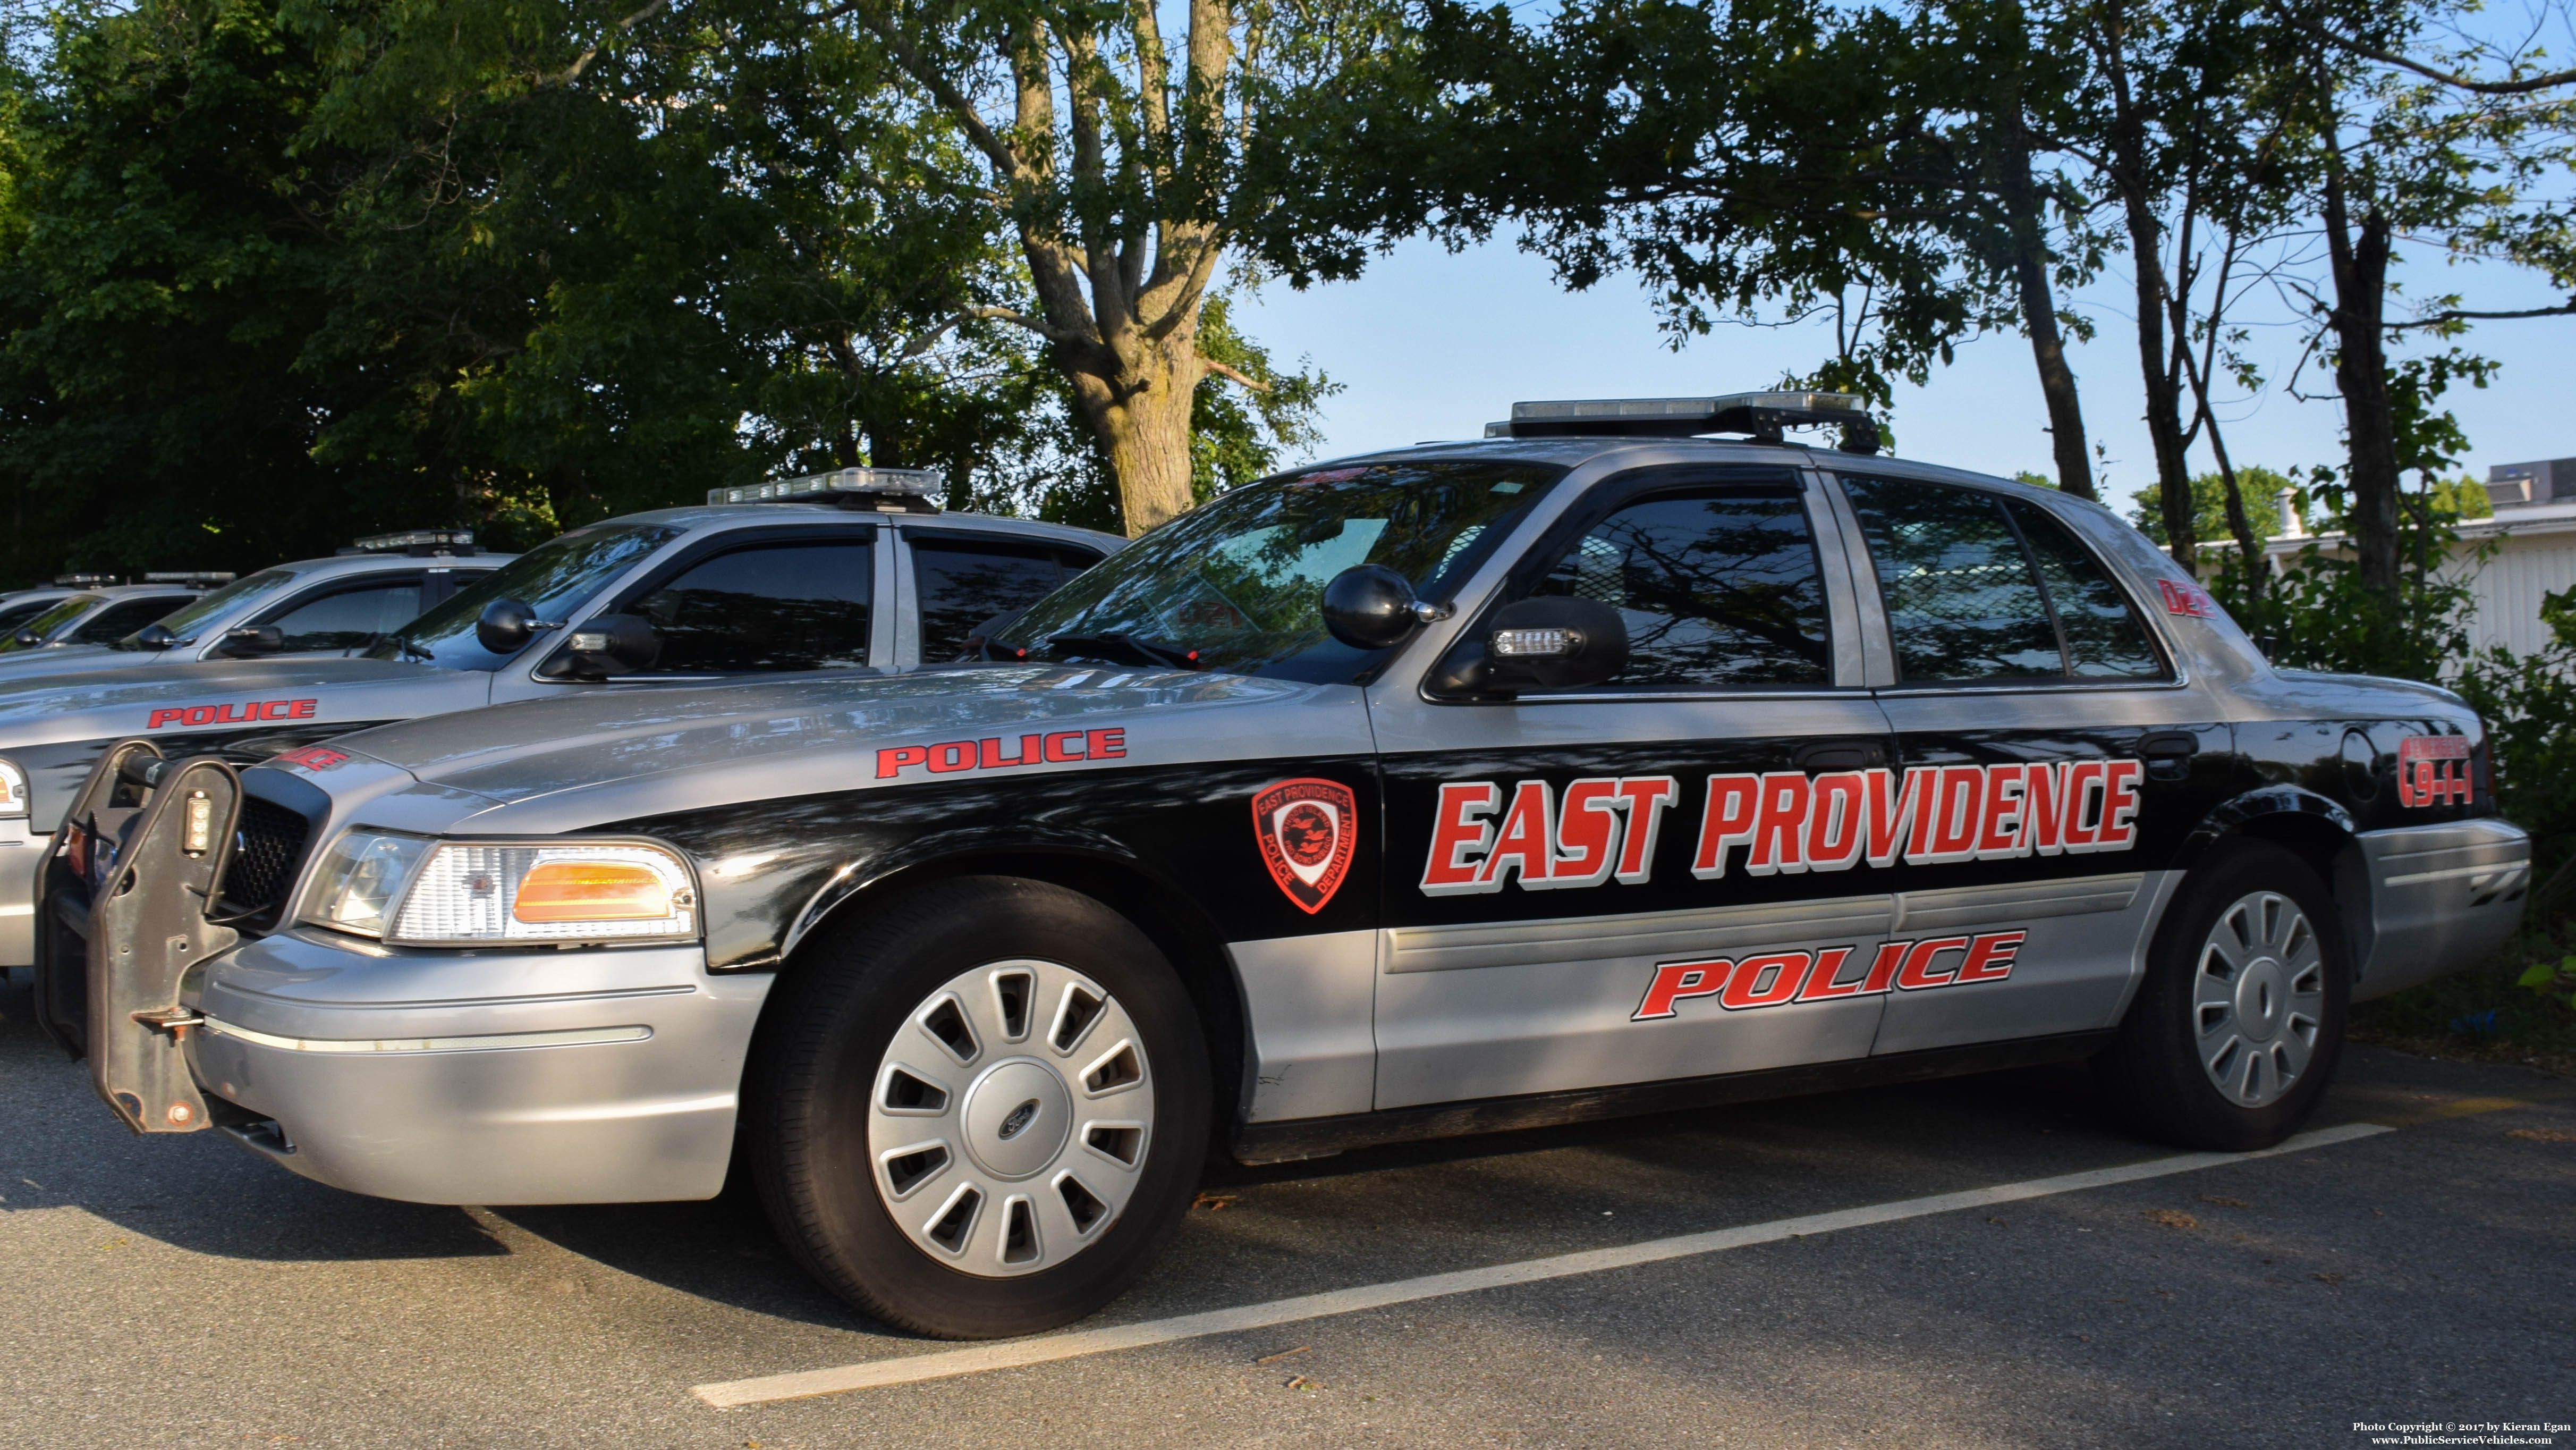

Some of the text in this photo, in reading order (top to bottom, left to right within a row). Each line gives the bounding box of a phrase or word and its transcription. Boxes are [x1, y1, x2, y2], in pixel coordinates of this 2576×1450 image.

[147, 698, 318, 729] POLICE
[875, 727, 1127, 779] POLICE
[1259, 785, 1350, 815] EAST PROVIDENCE
[1317, 812, 1351, 895] DEPARTMENT
[1419, 760, 2143, 897] EAST PROVIDENCE
[1262, 833, 1295, 885] POLICE
[1631, 929, 2027, 1021] POLICE
